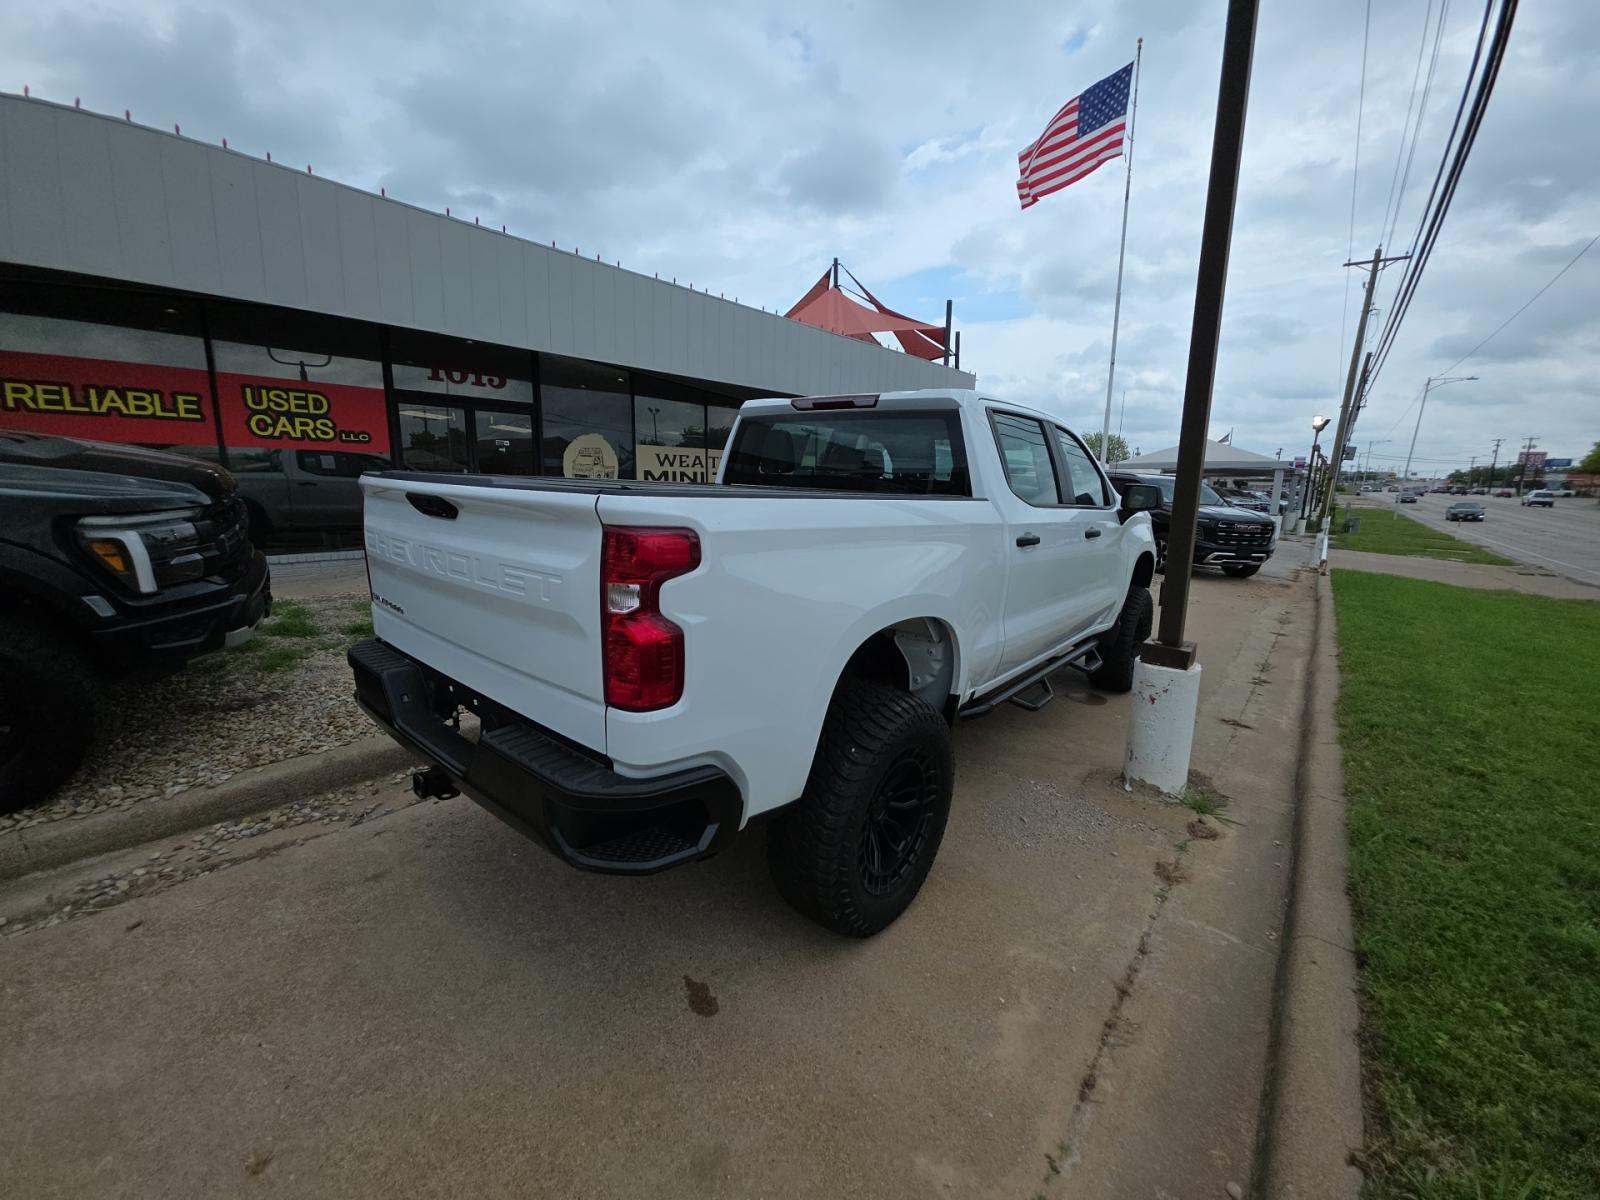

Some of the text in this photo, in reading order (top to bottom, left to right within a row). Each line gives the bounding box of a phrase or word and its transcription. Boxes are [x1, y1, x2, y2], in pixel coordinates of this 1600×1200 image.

[3, 381, 202, 420] RELIABLE
[244, 386, 329, 416] USED
[250, 414, 370, 442] CARS LLC
[655, 453, 722, 469] WEAT
[366, 529, 564, 602] CHEVROLET
